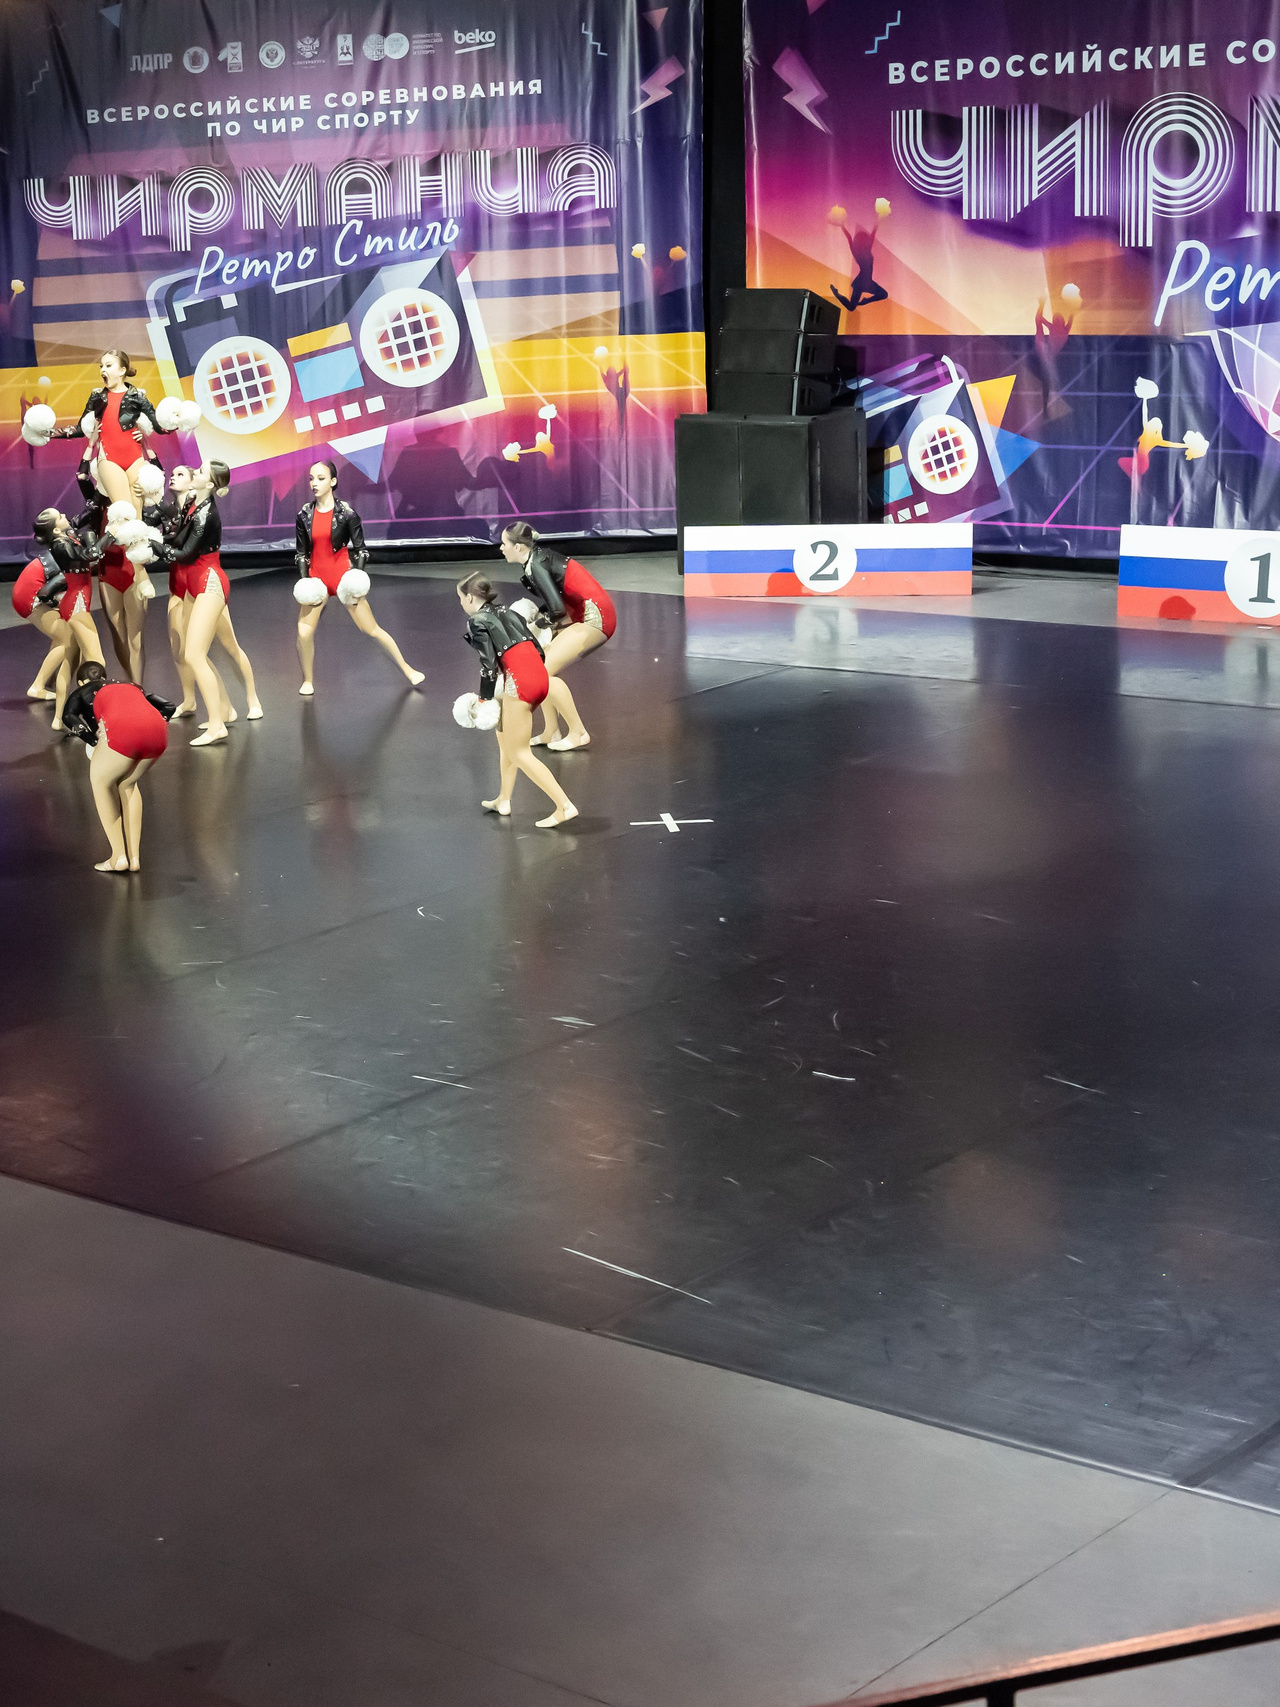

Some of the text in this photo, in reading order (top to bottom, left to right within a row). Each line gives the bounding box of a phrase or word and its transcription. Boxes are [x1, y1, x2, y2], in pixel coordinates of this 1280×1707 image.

[453, 28, 496, 45] beko
[129, 53, 173, 73] ЛДПР
[888, 38, 1277, 85] ВСЕРОССИЙСКИЕ СО
[86, 79, 543, 124] ВСЕРОССИЙСКИЕ СОРЕВНОВАНИЯ
[206, 108, 420, 138] ПО ЧИР СПОРТУ
[194, 218, 460, 295] Ретро Стиль
[808, 539, 840, 582] 2
[1248, 551, 1276, 604] 1
